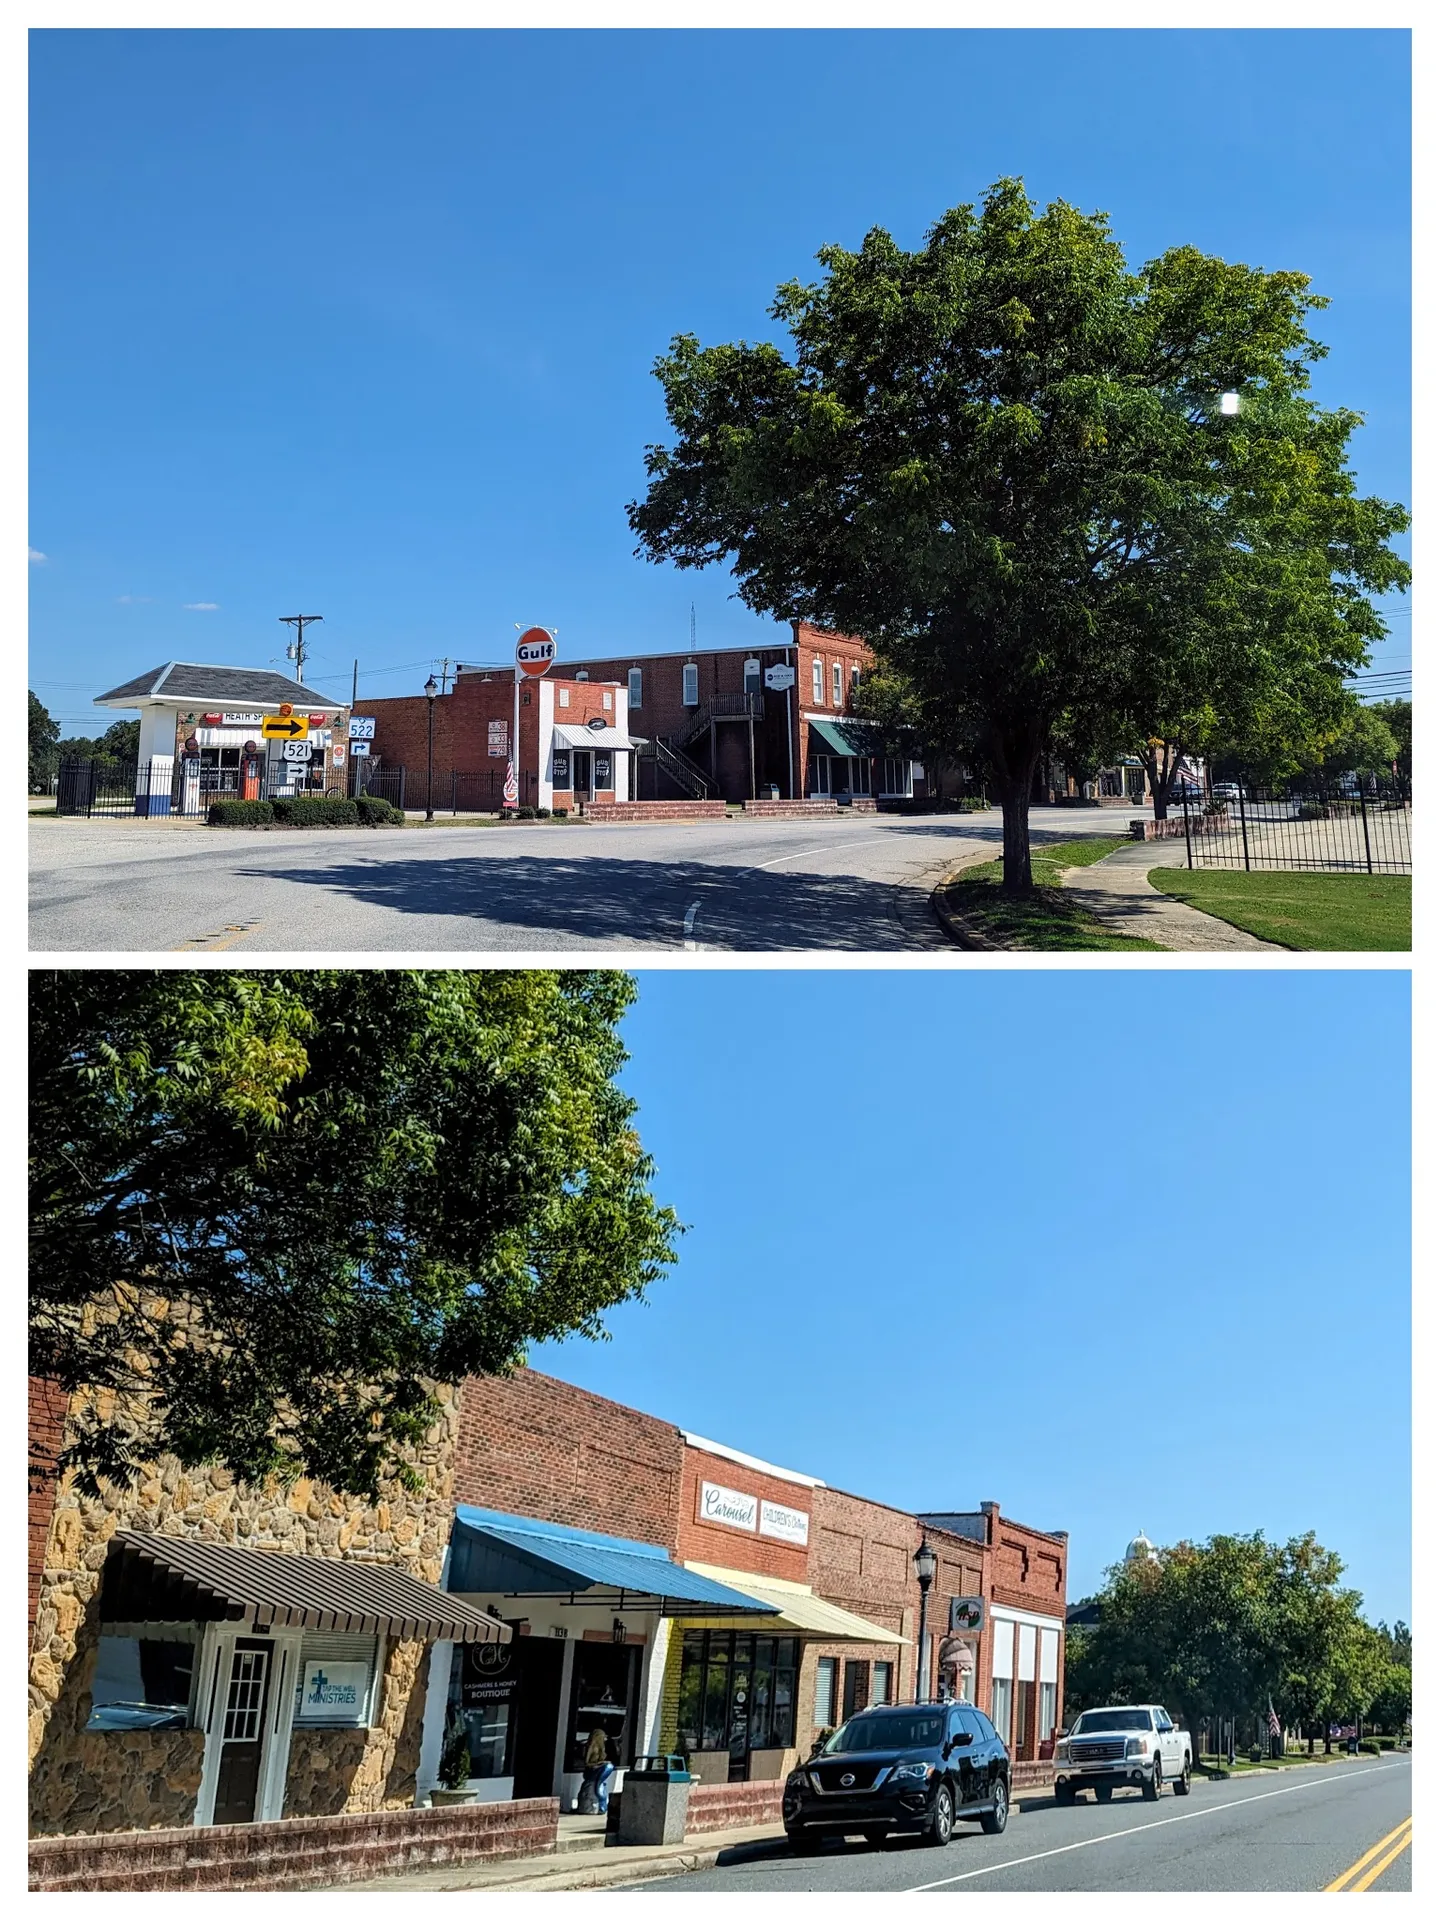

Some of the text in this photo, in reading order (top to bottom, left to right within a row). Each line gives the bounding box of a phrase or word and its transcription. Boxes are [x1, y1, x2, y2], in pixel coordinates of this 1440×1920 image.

[518, 644, 553, 660] Gulf
[226, 712, 251, 721] HEATH
[350, 724, 373, 737] 522
[288, 744, 308, 757] 521
[553, 768, 568, 776] STOP
[705, 1489, 755, 1524] Carousel
[332, 1684, 342, 1692] THE
[343, 1684, 356, 1692] WELL
[463, 1681, 493, 1689] CASHMERE
[308, 1692, 356, 1704] MINISTRIES
[471, 1689, 511, 1698] BOUTIQUE
